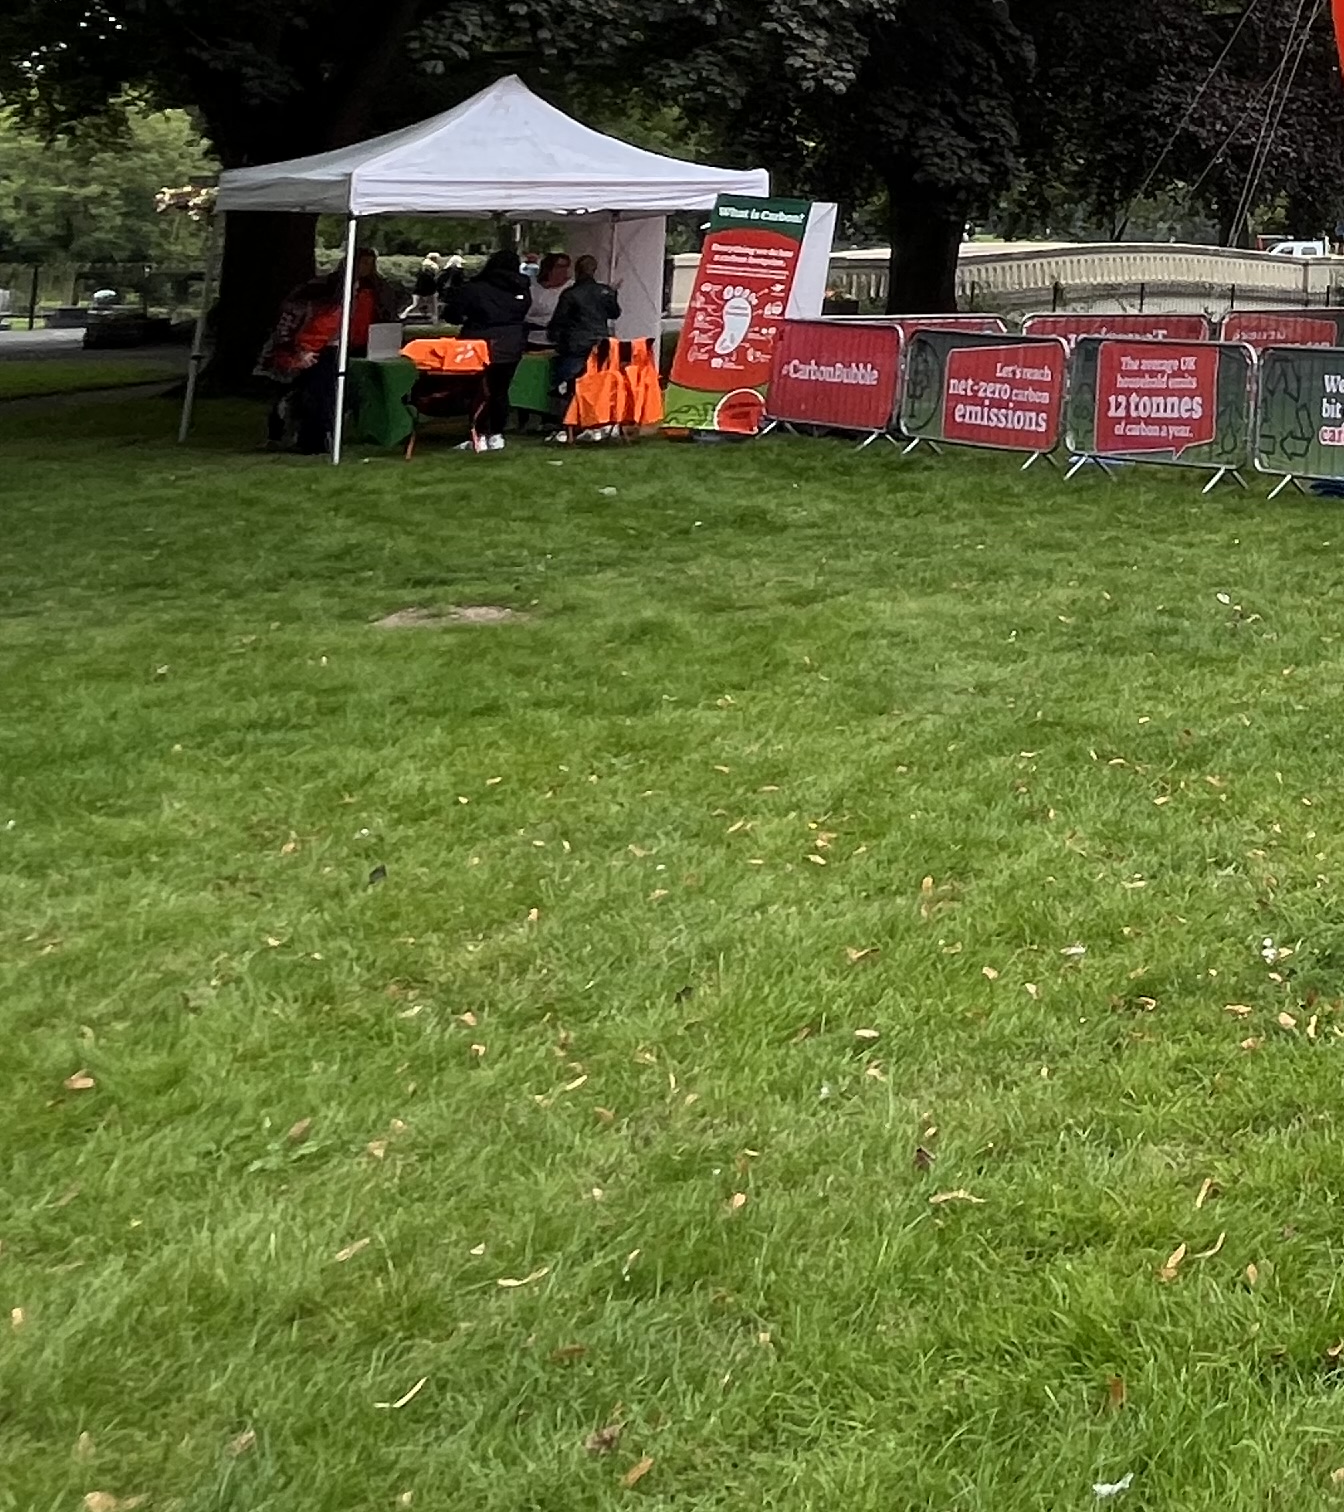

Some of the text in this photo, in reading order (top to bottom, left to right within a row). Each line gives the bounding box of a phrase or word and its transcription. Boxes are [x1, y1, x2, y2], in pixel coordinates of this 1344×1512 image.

[782, 360, 878, 385] #CarbonBubble
[1121, 356, 1139, 370] The
[948, 377, 1050, 403] net-zero carbon
[954, 400, 1047, 432] emissions
[1108, 392, 1202, 419] 12 tonnes
[1322, 398, 1342, 418] bit
